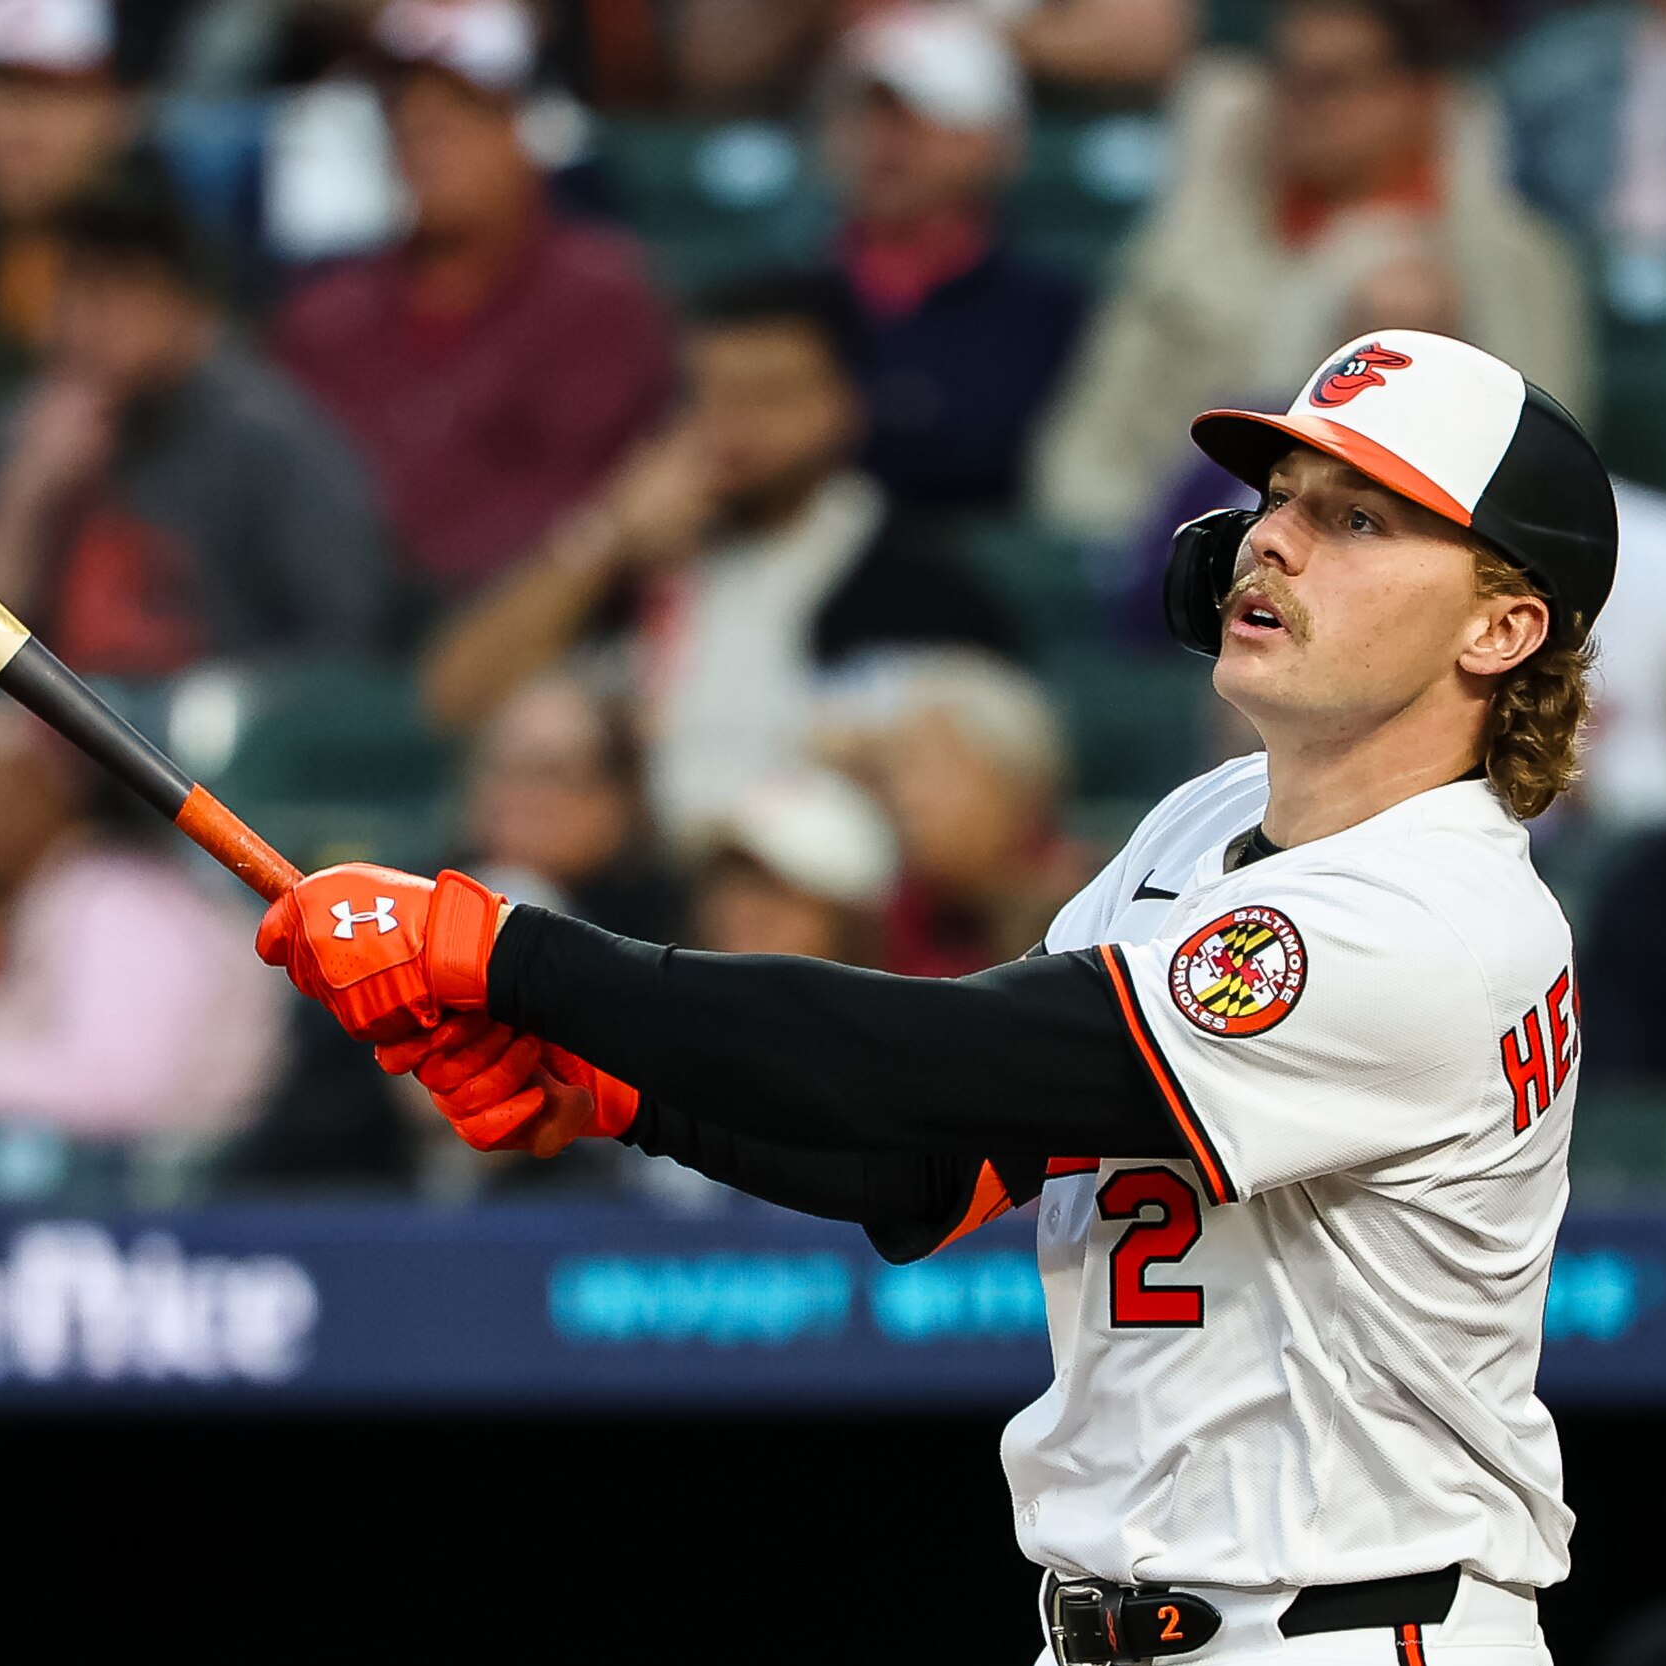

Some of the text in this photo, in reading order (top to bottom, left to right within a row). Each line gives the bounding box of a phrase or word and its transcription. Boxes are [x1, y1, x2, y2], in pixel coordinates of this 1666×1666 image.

[1173, 954, 1227, 1030] ORIOLES
[1234, 909, 1302, 1005] BALTIMORE
[1500, 965, 1580, 1137] HE
[1095, 1165, 1205, 1329] 2
[1158, 1605, 1183, 1641] 2
